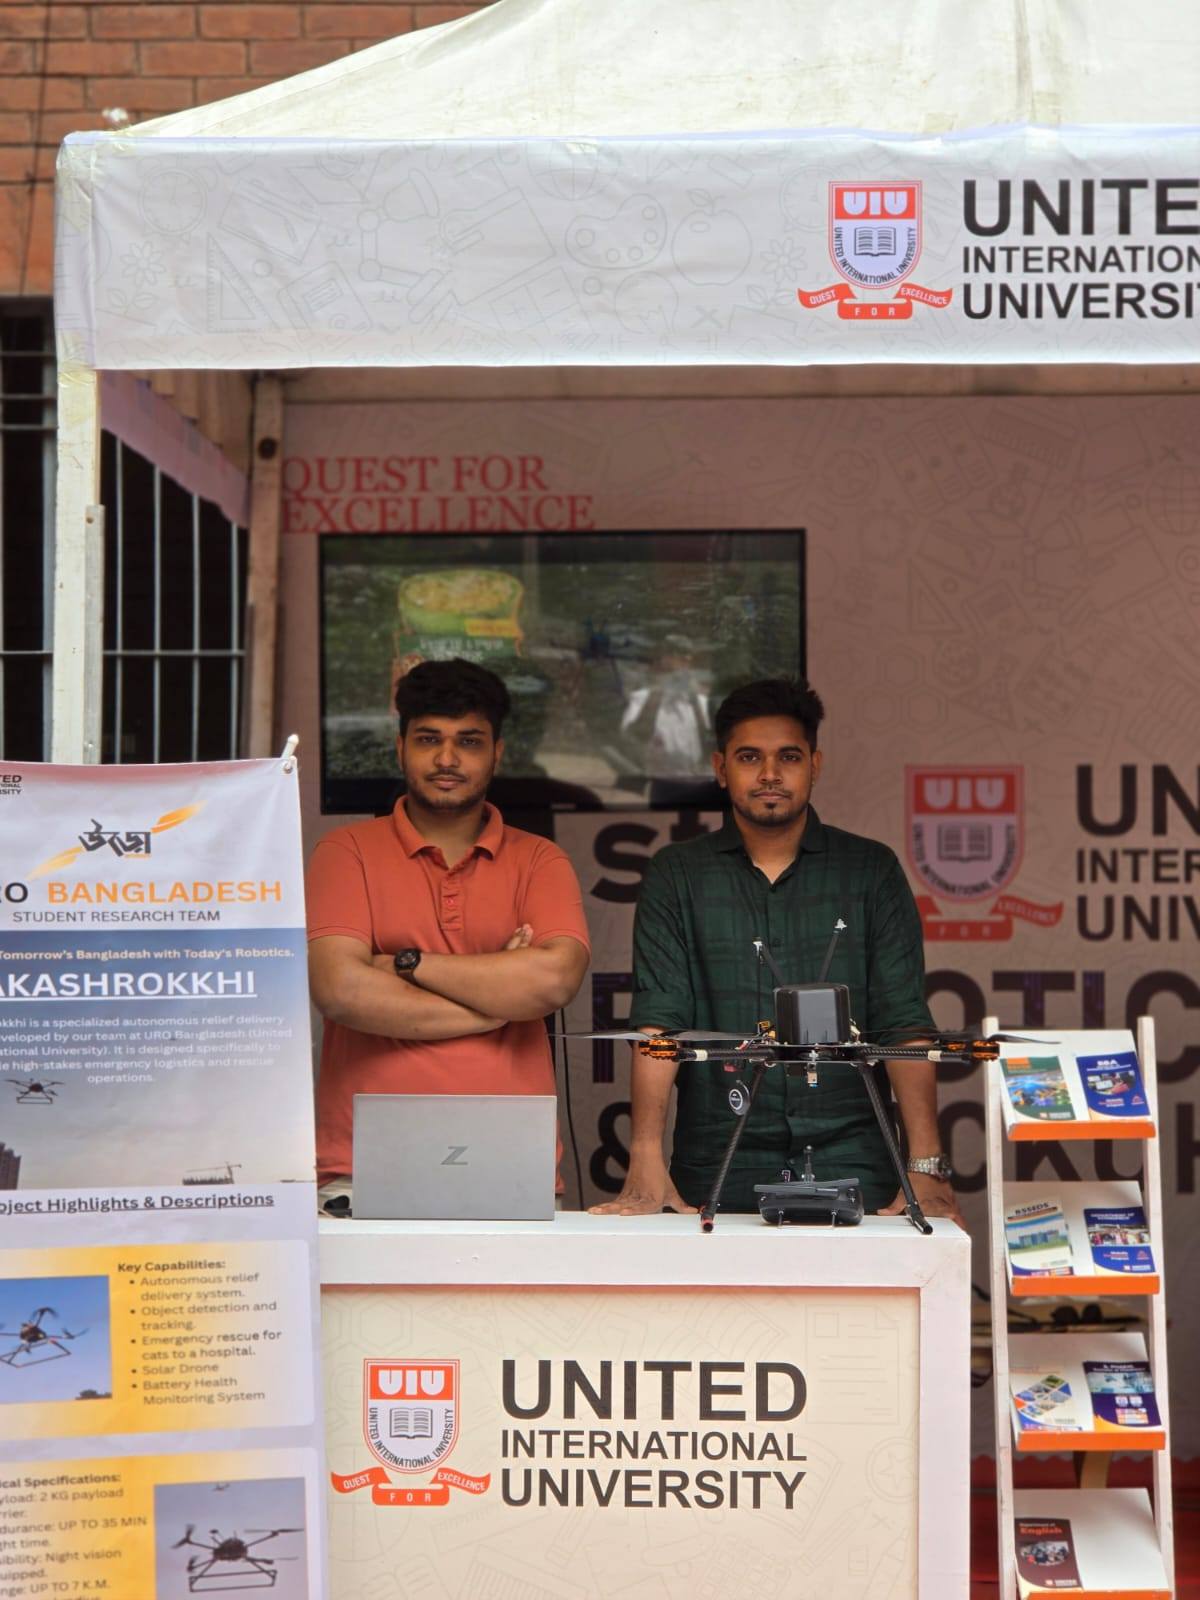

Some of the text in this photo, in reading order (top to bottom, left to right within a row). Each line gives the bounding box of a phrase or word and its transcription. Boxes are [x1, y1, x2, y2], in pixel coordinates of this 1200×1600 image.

[843, 191, 908, 216] UIU
[963, 179, 1200, 236] UNITE
[834, 226, 916, 284] UNITED INTERNATIONAL UNIVERSITY
[809, 288, 948, 316] QUEST FOR EXCELLENCE
[963, 282, 1200, 320] UNIVERSI
[281, 455, 549, 500] QUEST FOR
[281, 493, 596, 533] EXCELLENCE
[923, 778, 1006, 809] UIU
[0, 881, 281, 904] O BANGLADESH
[13, 910, 220, 922] STUDENT RESEARCH TEAM
[76, 949, 150, 961] Bangladesh
[153, 949, 181, 959] with
[184, 948, 232, 960] Today's
[235, 947, 295, 958] Robotics.
[0, 970, 256, 998] KASHROKKHI
[0, 1018, 26, 1028] kkhi
[30, 1018, 40, 1027] is
[53, 1017, 120, 1029] specialized
[123, 1017, 199, 1027] autonomous
[202, 1015, 234, 1025] relief
[236, 1014, 284, 1026] delivery
[54, 1032, 69, 1043] by
[72, 1033, 92, 1041] our
[95, 1032, 126, 1041] team
[129, 1032, 140, 1041] at
[144, 1030, 171, 1040] URO
[175, 1029, 245, 1041] Bangladesh
[114, 1046, 122, 1055] It
[126, 1045, 136, 1054] is
[138, 1044, 193, 1055] designed
[197, 1042, 265, 1054] specifically
[12, 1060, 82, 1072] high-stakes
[85, 1060, 151, 1071] emergency
[154, 1058, 205, 1070] logistics
[208, 1057, 230, 1067] and
[48, 1197, 139, 1214] Highlights
[143, 1196, 156, 1208] &
[161, 1193, 275, 1210] Descriptions
[117, 1260, 226, 1274] Key Capabilities:
[140, 1273, 260, 1287] Autonomous relief
[141, 1289, 246, 1303] delivery system.
[141, 1301, 278, 1318] Object detection and
[141, 1320, 197, 1333] tracking.
[142, 1330, 283, 1347] Emergency rescue for
[142, 1346, 256, 1361] cats to a hospital.
[142, 1362, 219, 1375] Solar Drone
[143, 1377, 238, 1391] Battery Health
[378, 1370, 446, 1395] UIU
[502, 1359, 807, 1422] UNITED
[144, 1390, 266, 1406] Monitoring System
[369, 1407, 454, 1468] UNITED INTERNATIONAL UNIVERSITY
[502, 1429, 807, 1461] INTERNATIONAL
[24, 1474, 121, 1489] Specifications:
[343, 1471, 486, 1502] QUEST FOR EXCELLENCE
[502, 1468, 807, 1510] UNIVERSITY
[40, 1492, 47, 1501] 2
[51, 1490, 69, 1501] KG
[72, 1488, 124, 1502] payload
[58, 1520, 77, 1531] UP
[81, 1519, 98, 1529] TO
[102, 1518, 118, 1528] 35
[121, 1516, 147, 1527] MIN
[20, 1539, 51, 1549] time.
[45, 1551, 79, 1564] Night
[83, 1549, 122, 1560] vision
[30, 1583, 48, 1594] UP
[52, 1581, 69, 1592] TO
[72, 1581, 80, 1591] 7
[82, 1579, 111, 1590] K.M.
